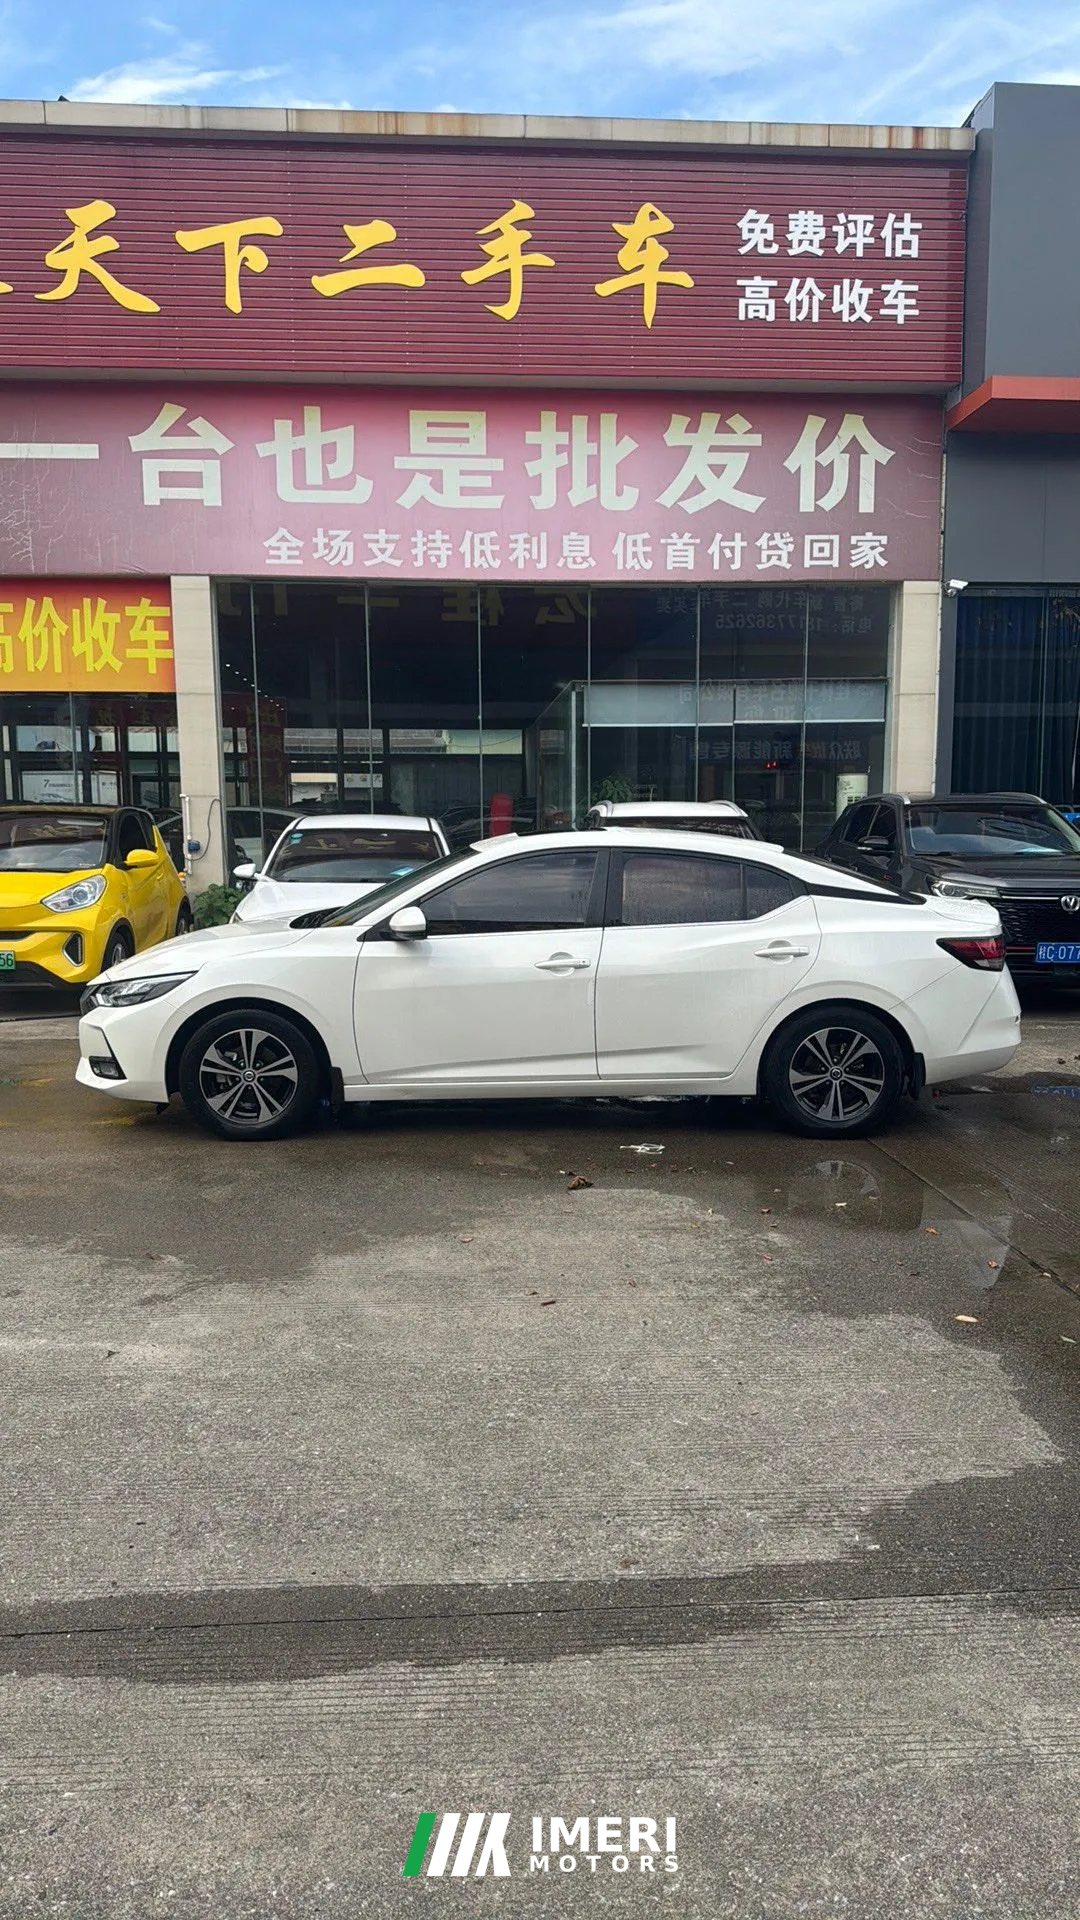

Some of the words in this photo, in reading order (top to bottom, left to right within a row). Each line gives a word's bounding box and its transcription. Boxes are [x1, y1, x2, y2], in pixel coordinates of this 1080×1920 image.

[0, 199, 695, 329] 天下二手车
[736, 208, 923, 259] 免费评估
[736, 275, 920, 325] 高价收车
[0, 402, 896, 514] 一台也是批发价
[263, 527, 596, 569] 全场支持低利息
[612, 531, 889, 570] 低首付贷回家
[0, 596, 174, 674] 价收车
